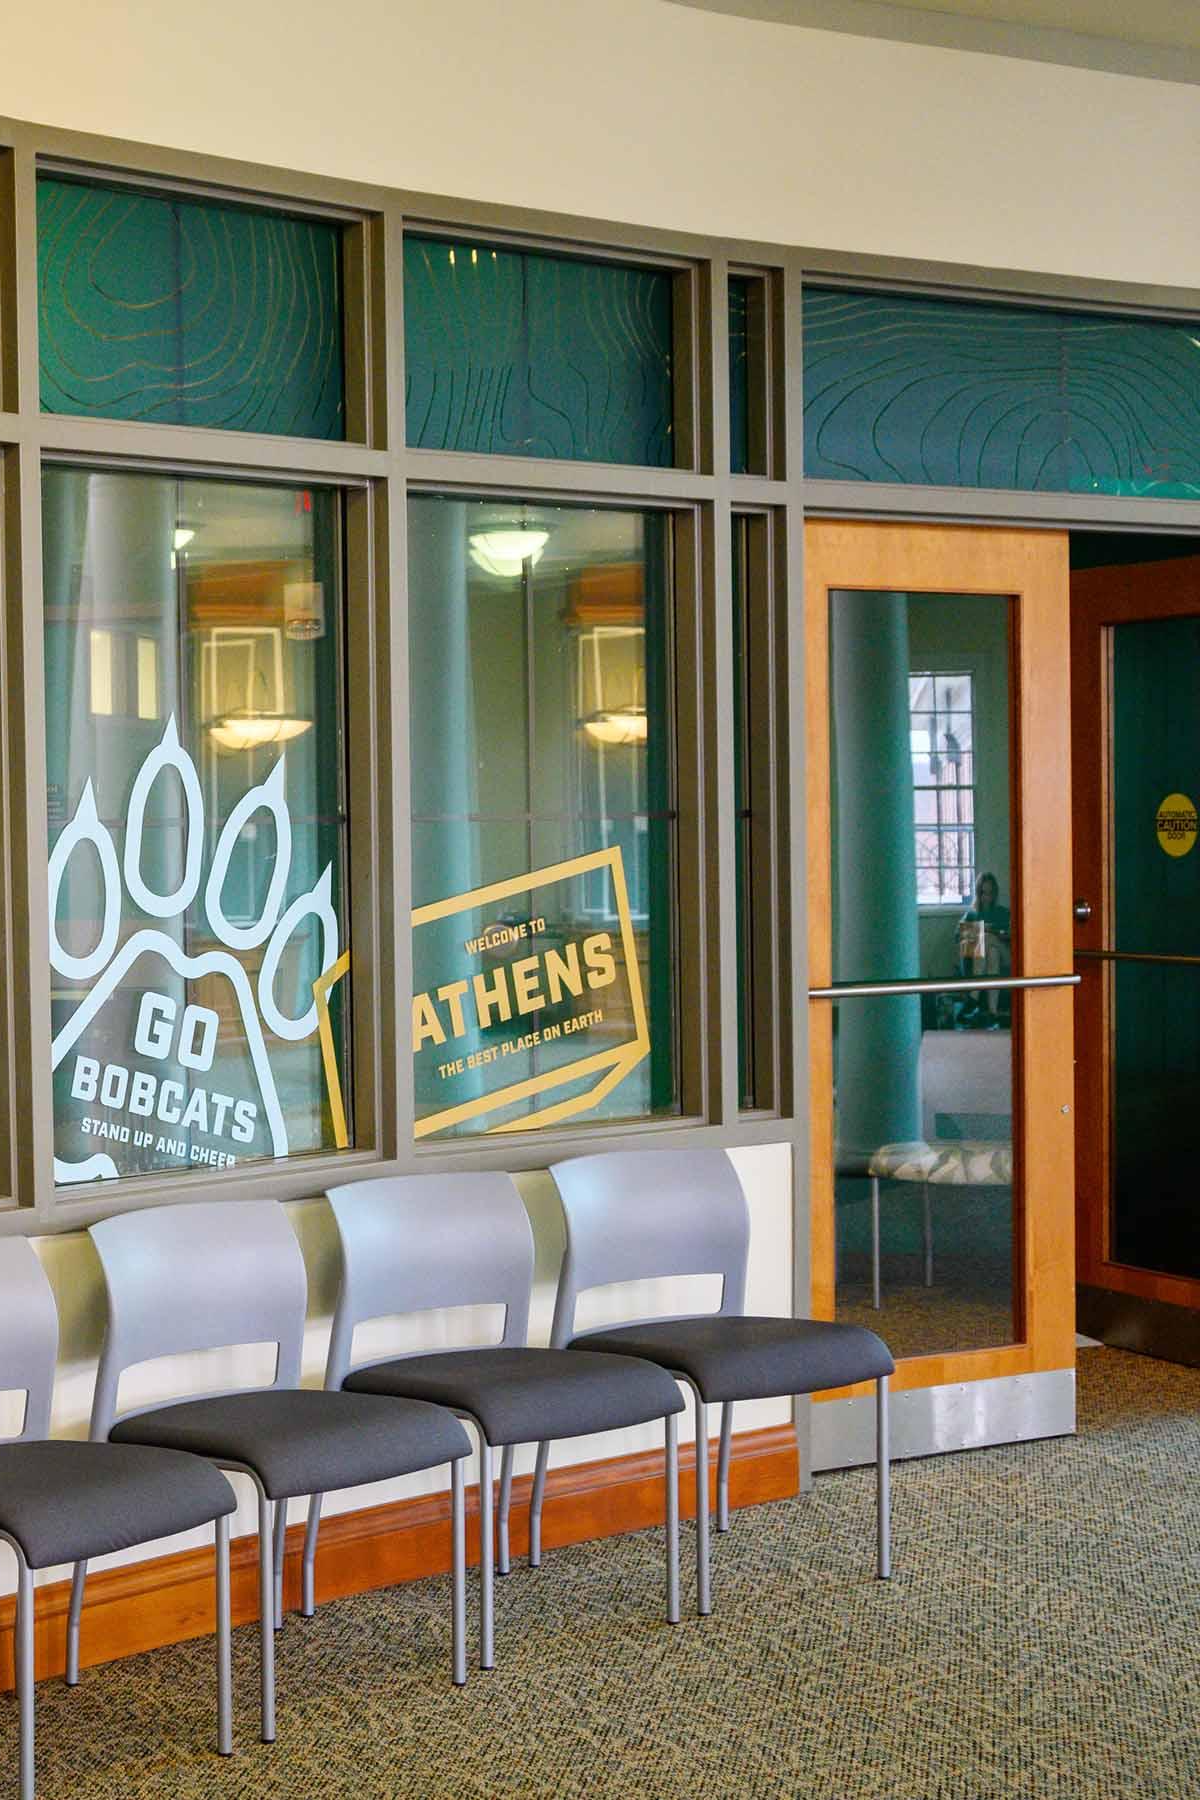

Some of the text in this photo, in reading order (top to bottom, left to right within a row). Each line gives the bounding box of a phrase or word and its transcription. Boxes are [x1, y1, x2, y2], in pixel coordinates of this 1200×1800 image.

[1156, 820, 1197, 831] CAUTION
[464, 917, 546, 956] WELCOME TO
[412, 932, 617, 1053] ATHENS
[134, 991, 220, 1072] GO
[438, 1009, 603, 1079] THE BEST PLACE ON EARTH
[71, 1055, 258, 1143] BOBCATS
[81, 1117, 236, 1167] STAND UP AND CHEER
